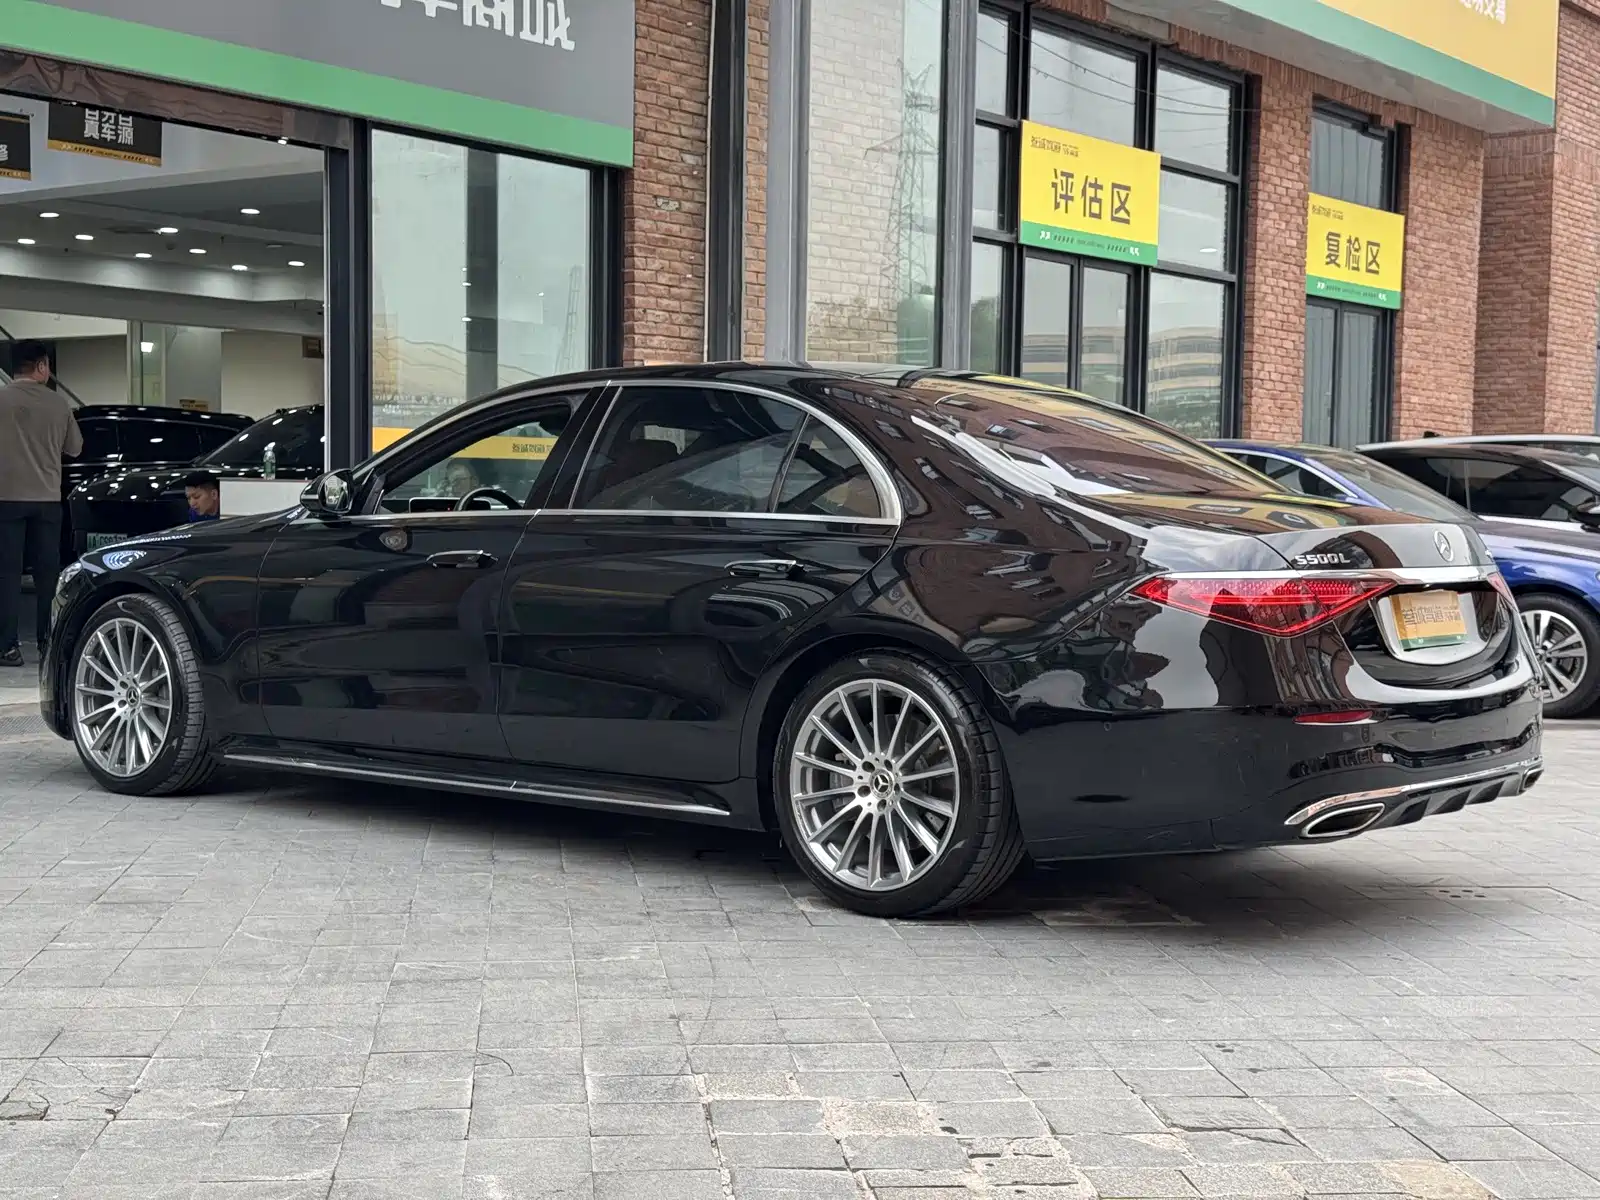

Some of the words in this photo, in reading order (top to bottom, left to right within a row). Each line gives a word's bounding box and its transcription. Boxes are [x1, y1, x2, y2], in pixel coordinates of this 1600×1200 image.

[84, 119, 134, 145] 真车源
[1051, 168, 1131, 225] 评估区
[1325, 231, 1380, 275] 复检区
[1294, 552, 1350, 565] S500L
